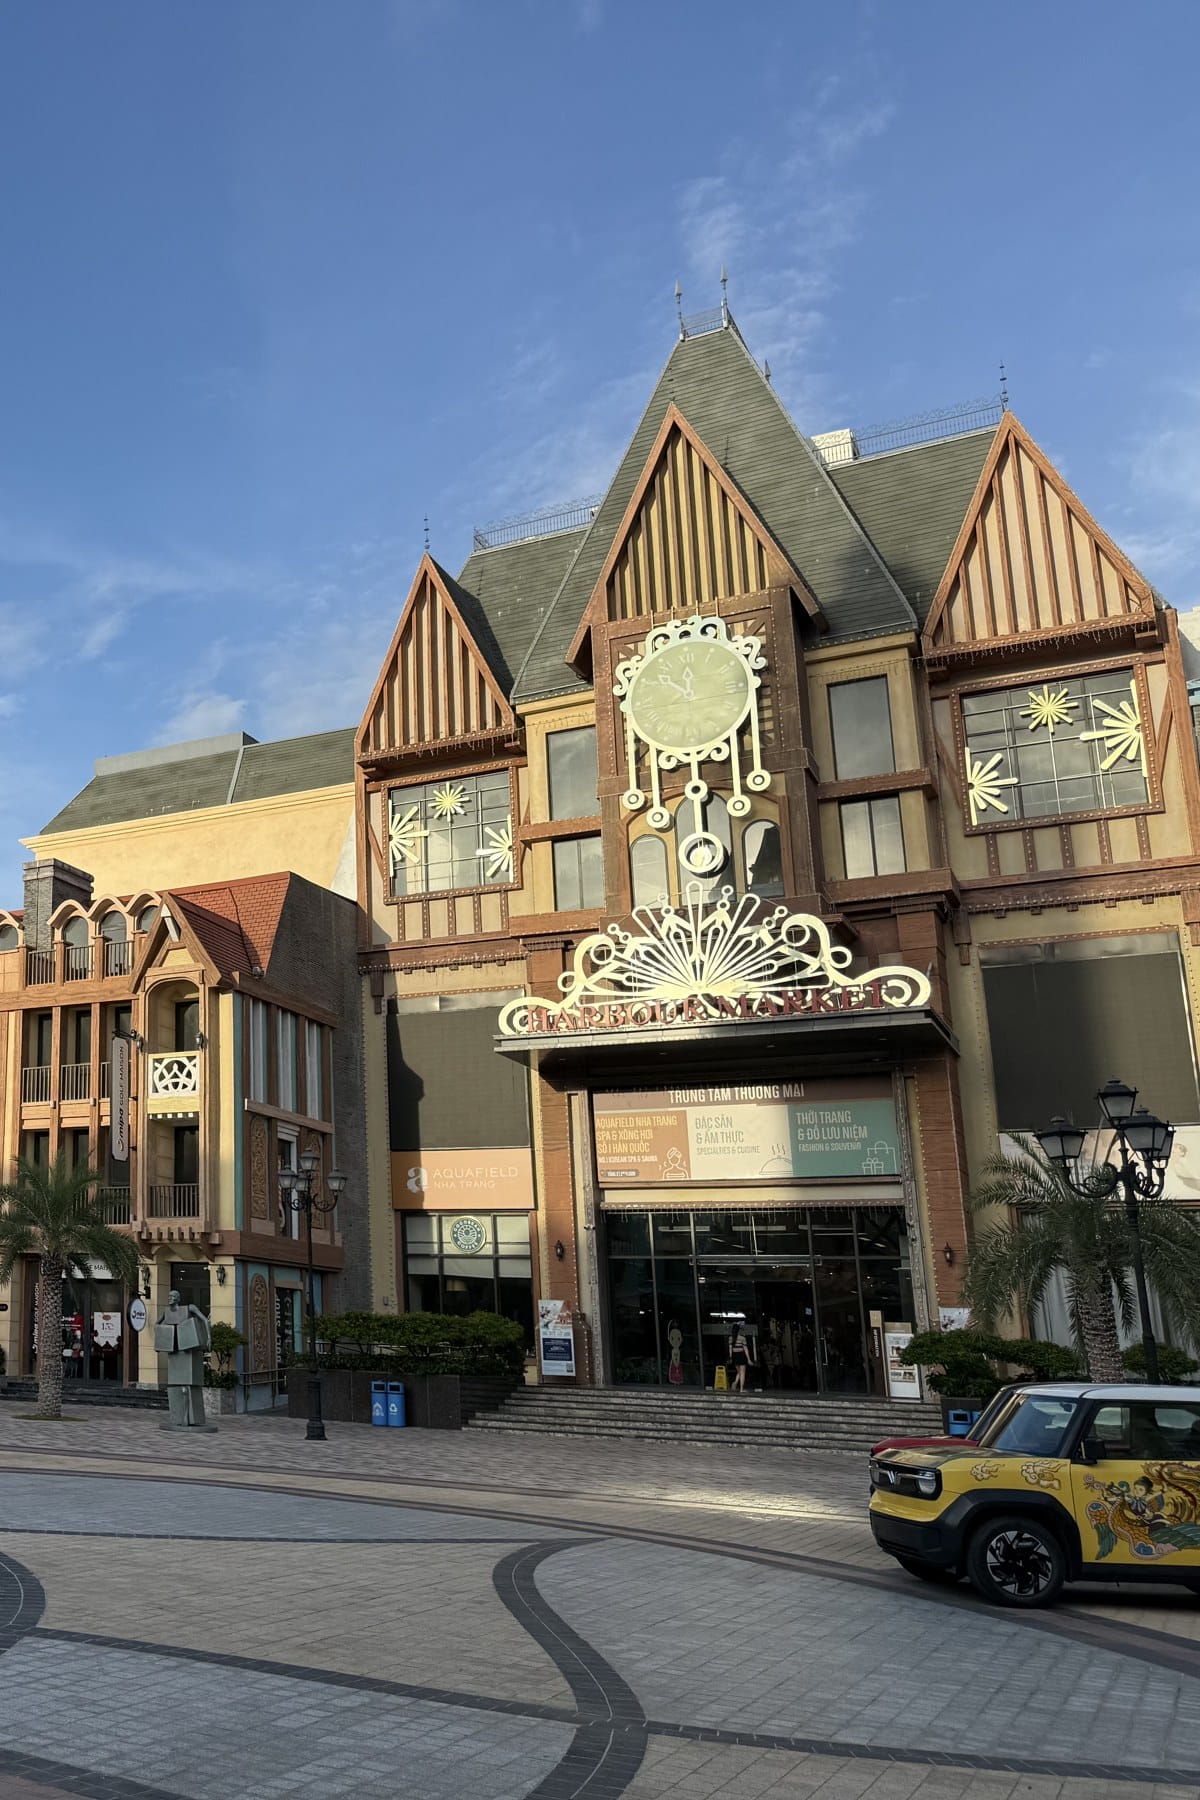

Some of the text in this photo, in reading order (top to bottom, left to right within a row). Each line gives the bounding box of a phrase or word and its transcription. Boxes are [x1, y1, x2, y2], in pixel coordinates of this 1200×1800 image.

[526, 983, 888, 1032] HARBOUR MARKET
[669, 1088, 706, 1104] TRUNG
[596, 1115, 677, 1129] AQUAFIELD NHA TRANG
[818, 1110, 852, 1125] TRANG
[597, 1131, 611, 1141] SPA
[798, 1143, 824, 1152] FASHION
[831, 1142, 862, 1151] SOUVENIR
[433, 1167, 519, 1179] AQUAFIELD
[433, 1180, 496, 1189] NHA TRANG
